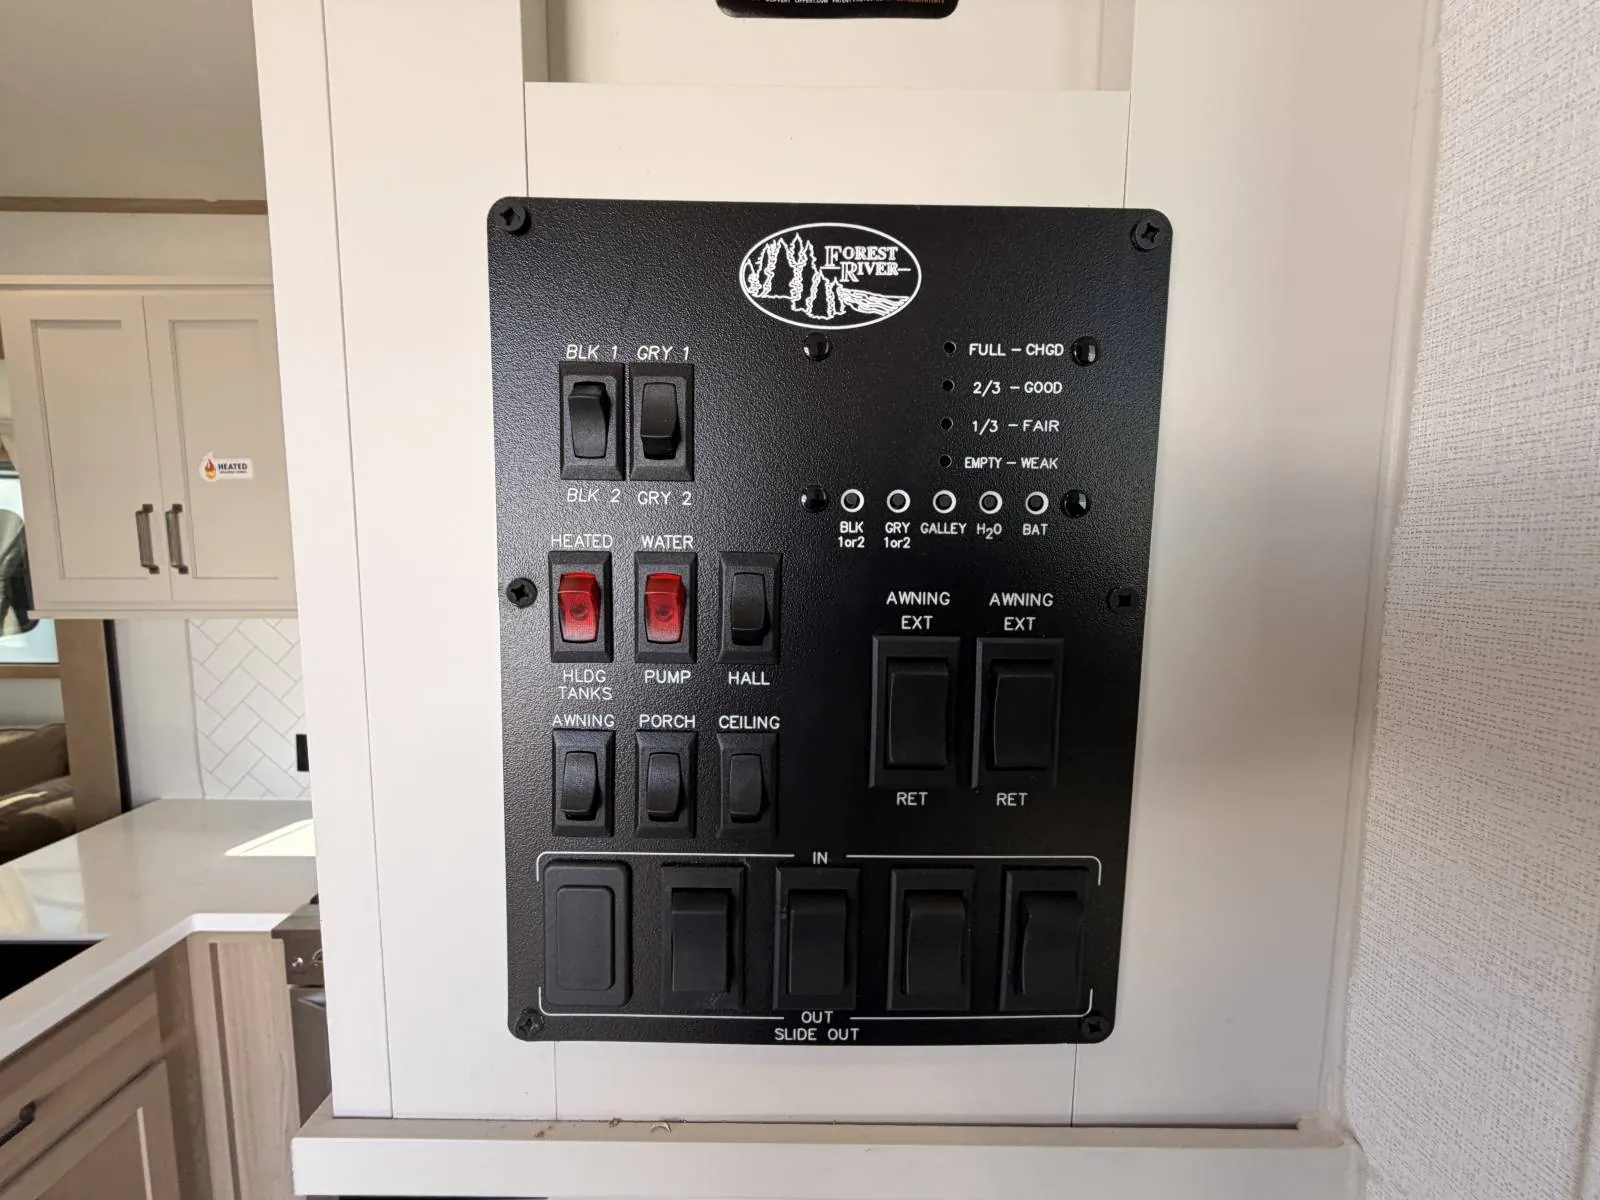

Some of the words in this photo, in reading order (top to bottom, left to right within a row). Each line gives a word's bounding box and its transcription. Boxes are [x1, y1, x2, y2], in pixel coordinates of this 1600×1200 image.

[824, 245, 899, 269] FOREST
[840, 260, 899, 283] RIVER
[565, 345, 601, 360] BLK
[610, 345, 619, 360] 1
[636, 345, 674, 361] GRY
[681, 345, 691, 361] 1
[968, 342, 1007, 357] FULL
[1025, 342, 1066, 358] CHGD
[972, 379, 1002, 398] 2/3
[1023, 379, 1064, 395] GOOD
[971, 417, 999, 436] 1/3
[1022, 418, 1061, 433] FAIR
[963, 455, 1004, 470] EMPTY
[1020, 455, 1060, 470] WEAK
[566, 488, 600, 503] BLK
[611, 488, 621, 504] 2
[637, 490, 672, 506] GRY
[681, 490, 693, 506] 2
[838, 520, 865, 534] BLK
[884, 520, 911, 535] GRY
[919, 521, 968, 536] GALLEY
[1021, 522, 1050, 536] BAT
[550, 533, 614, 549] HEATED
[640, 534, 695, 550] WATER
[837, 535, 866, 549] 1or2
[883, 535, 912, 549] 1or2
[886, 590, 951, 606] AWNING
[988, 592, 1054, 607] AWNING
[900, 614, 934, 630] EXT
[1003, 616, 1036, 631] EXT
[562, 669, 607, 684] HLDG
[643, 669, 692, 684] PUMP
[727, 670, 771, 686] HALL
[558, 685, 613, 701] TANKS
[551, 714, 616, 729] AWNING
[638, 714, 697, 729] PORCH
[717, 714, 781, 730] CEILING
[896, 791, 928, 806] RET
[996, 793, 1029, 806] RET
[812, 851, 828, 865] IN
[801, 1011, 834, 1024] OUT
[774, 1028, 817, 1041] SLIDE
[827, 1028, 860, 1041] OUT
